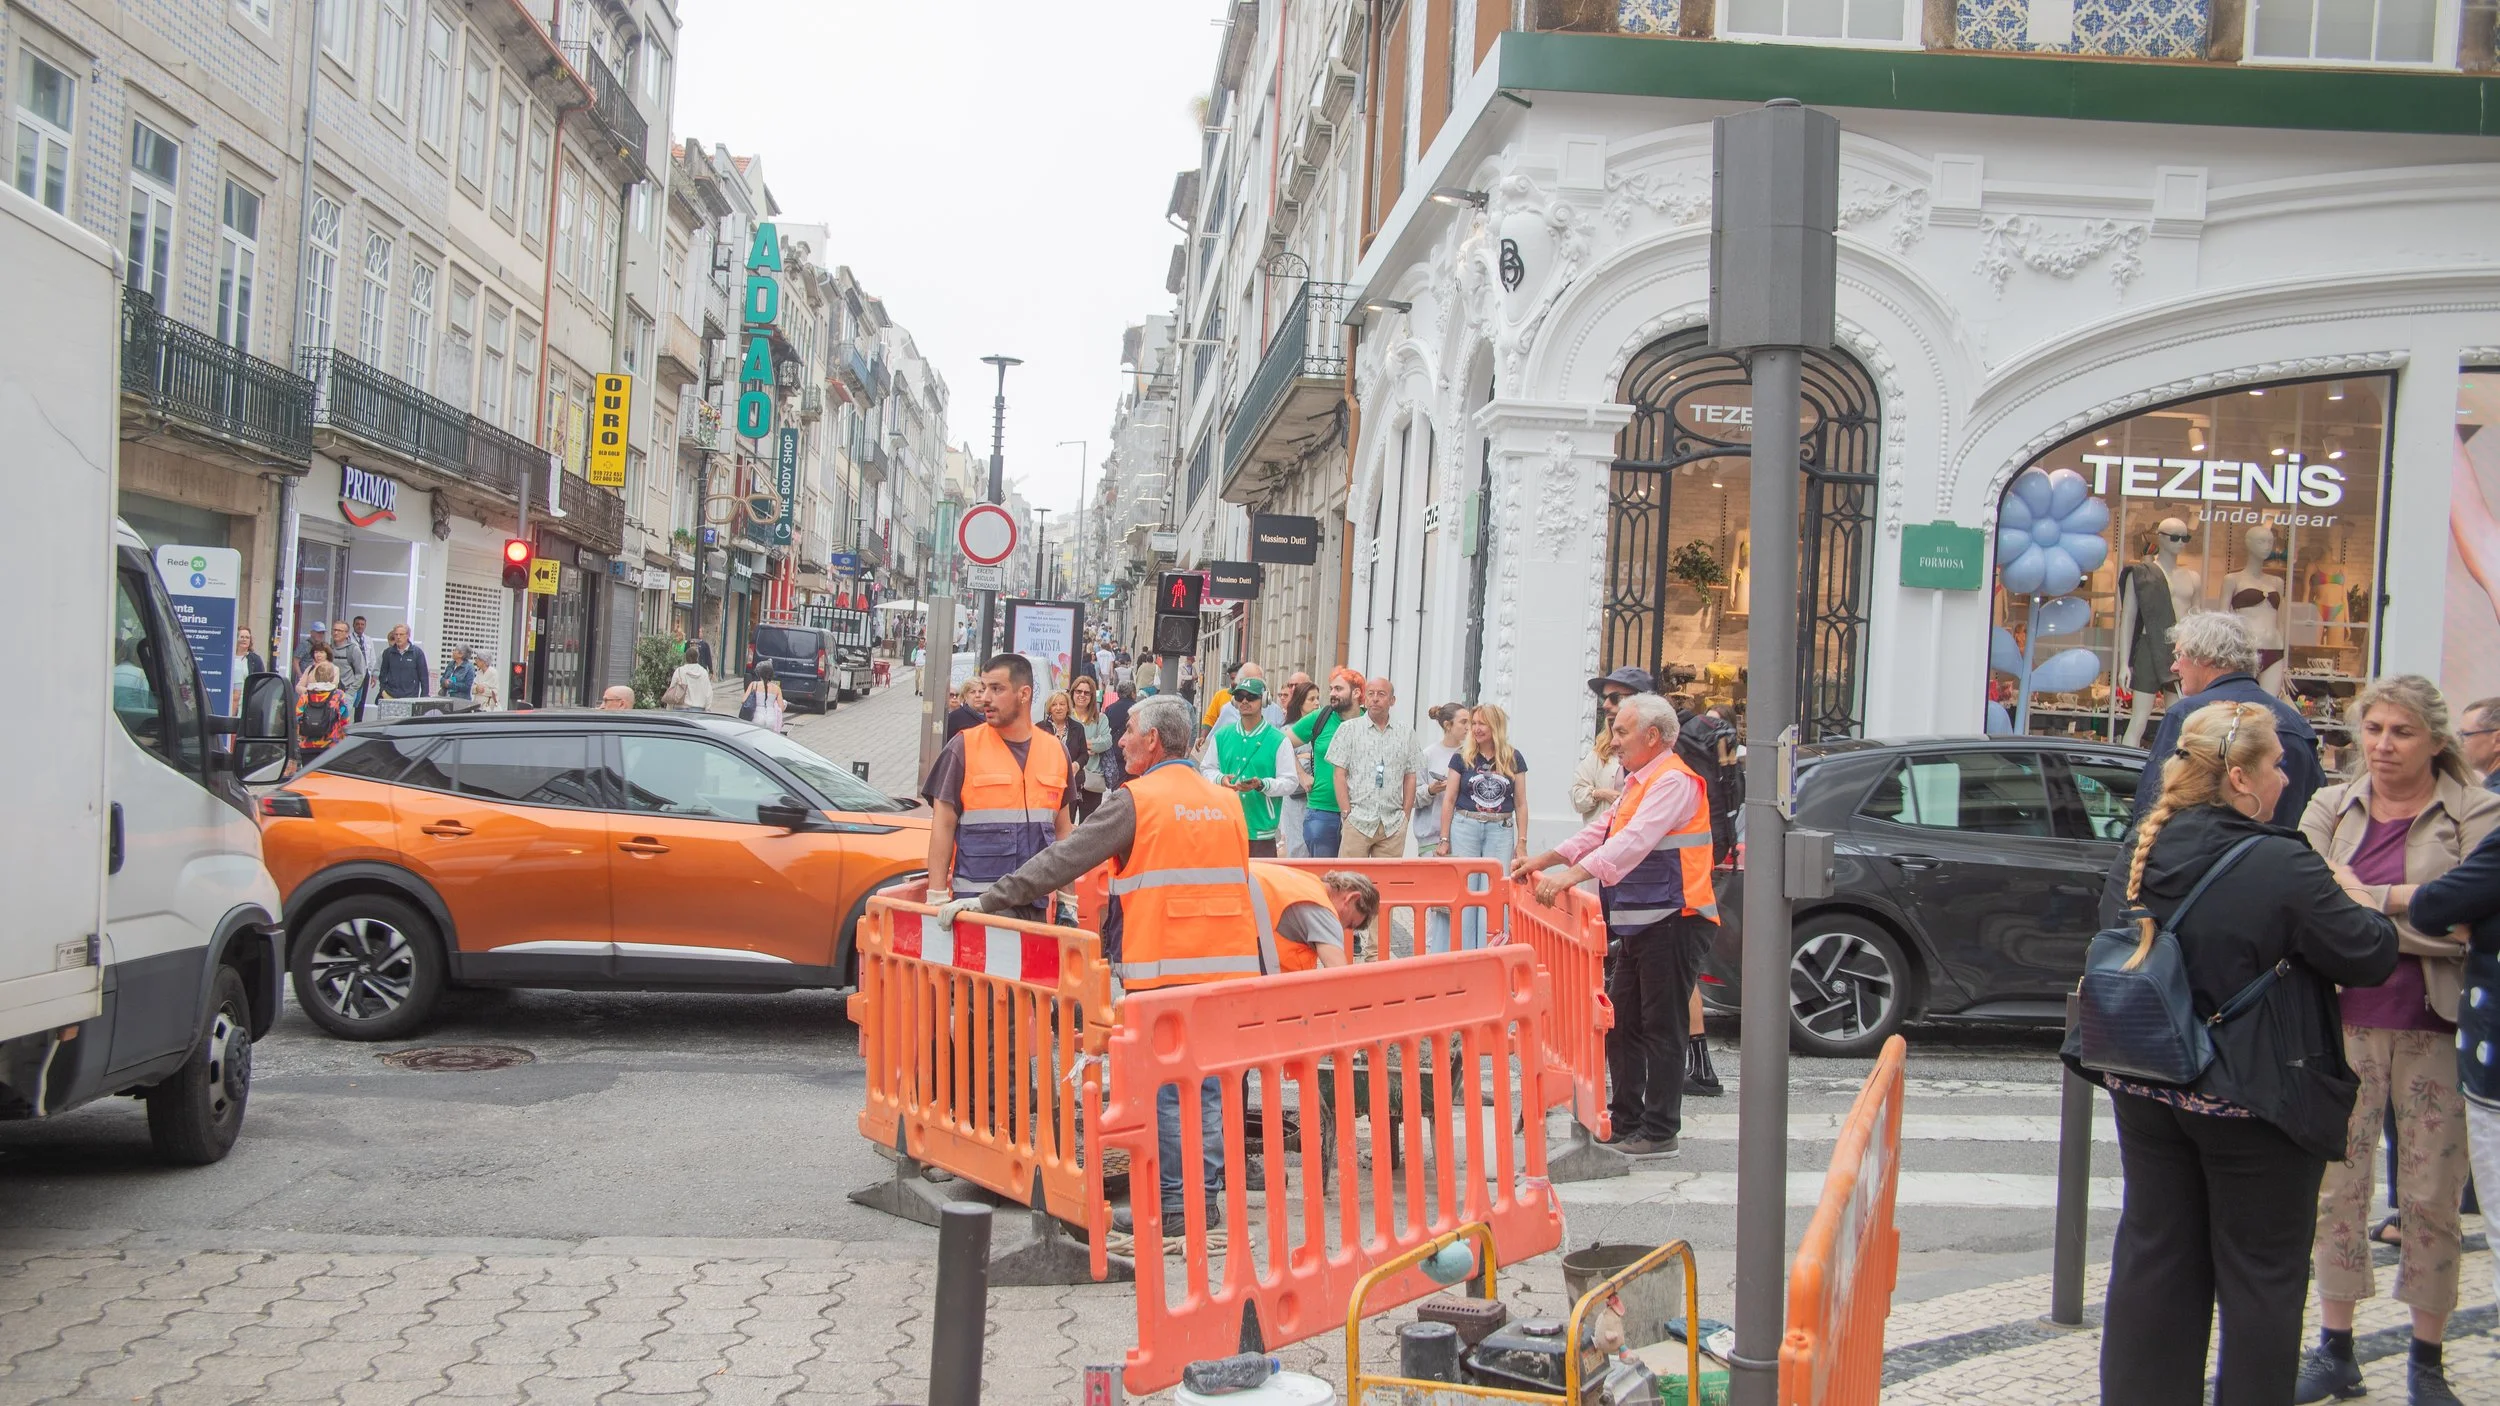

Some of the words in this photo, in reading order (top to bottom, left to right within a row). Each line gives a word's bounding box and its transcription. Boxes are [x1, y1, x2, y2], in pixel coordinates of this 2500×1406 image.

[737, 222, 782, 439] ADÃO
[601, 378, 622, 445] OURO
[783, 434, 794, 464] SHOP
[343, 465, 398, 512] PRIMOR
[781, 466, 791, 495] BODY
[780, 498, 790, 518] THE
[2199, 508, 2339, 527] underwear
[1261, 534, 1288, 544] Massimo
[1290, 536, 1307, 545] Dutti
[193, 560, 204, 568] 20
[1919, 557, 1964, 569] FORMOSA
[1216, 576, 1237, 584] Massimo
[1239, 577, 1252, 585] Dutti
